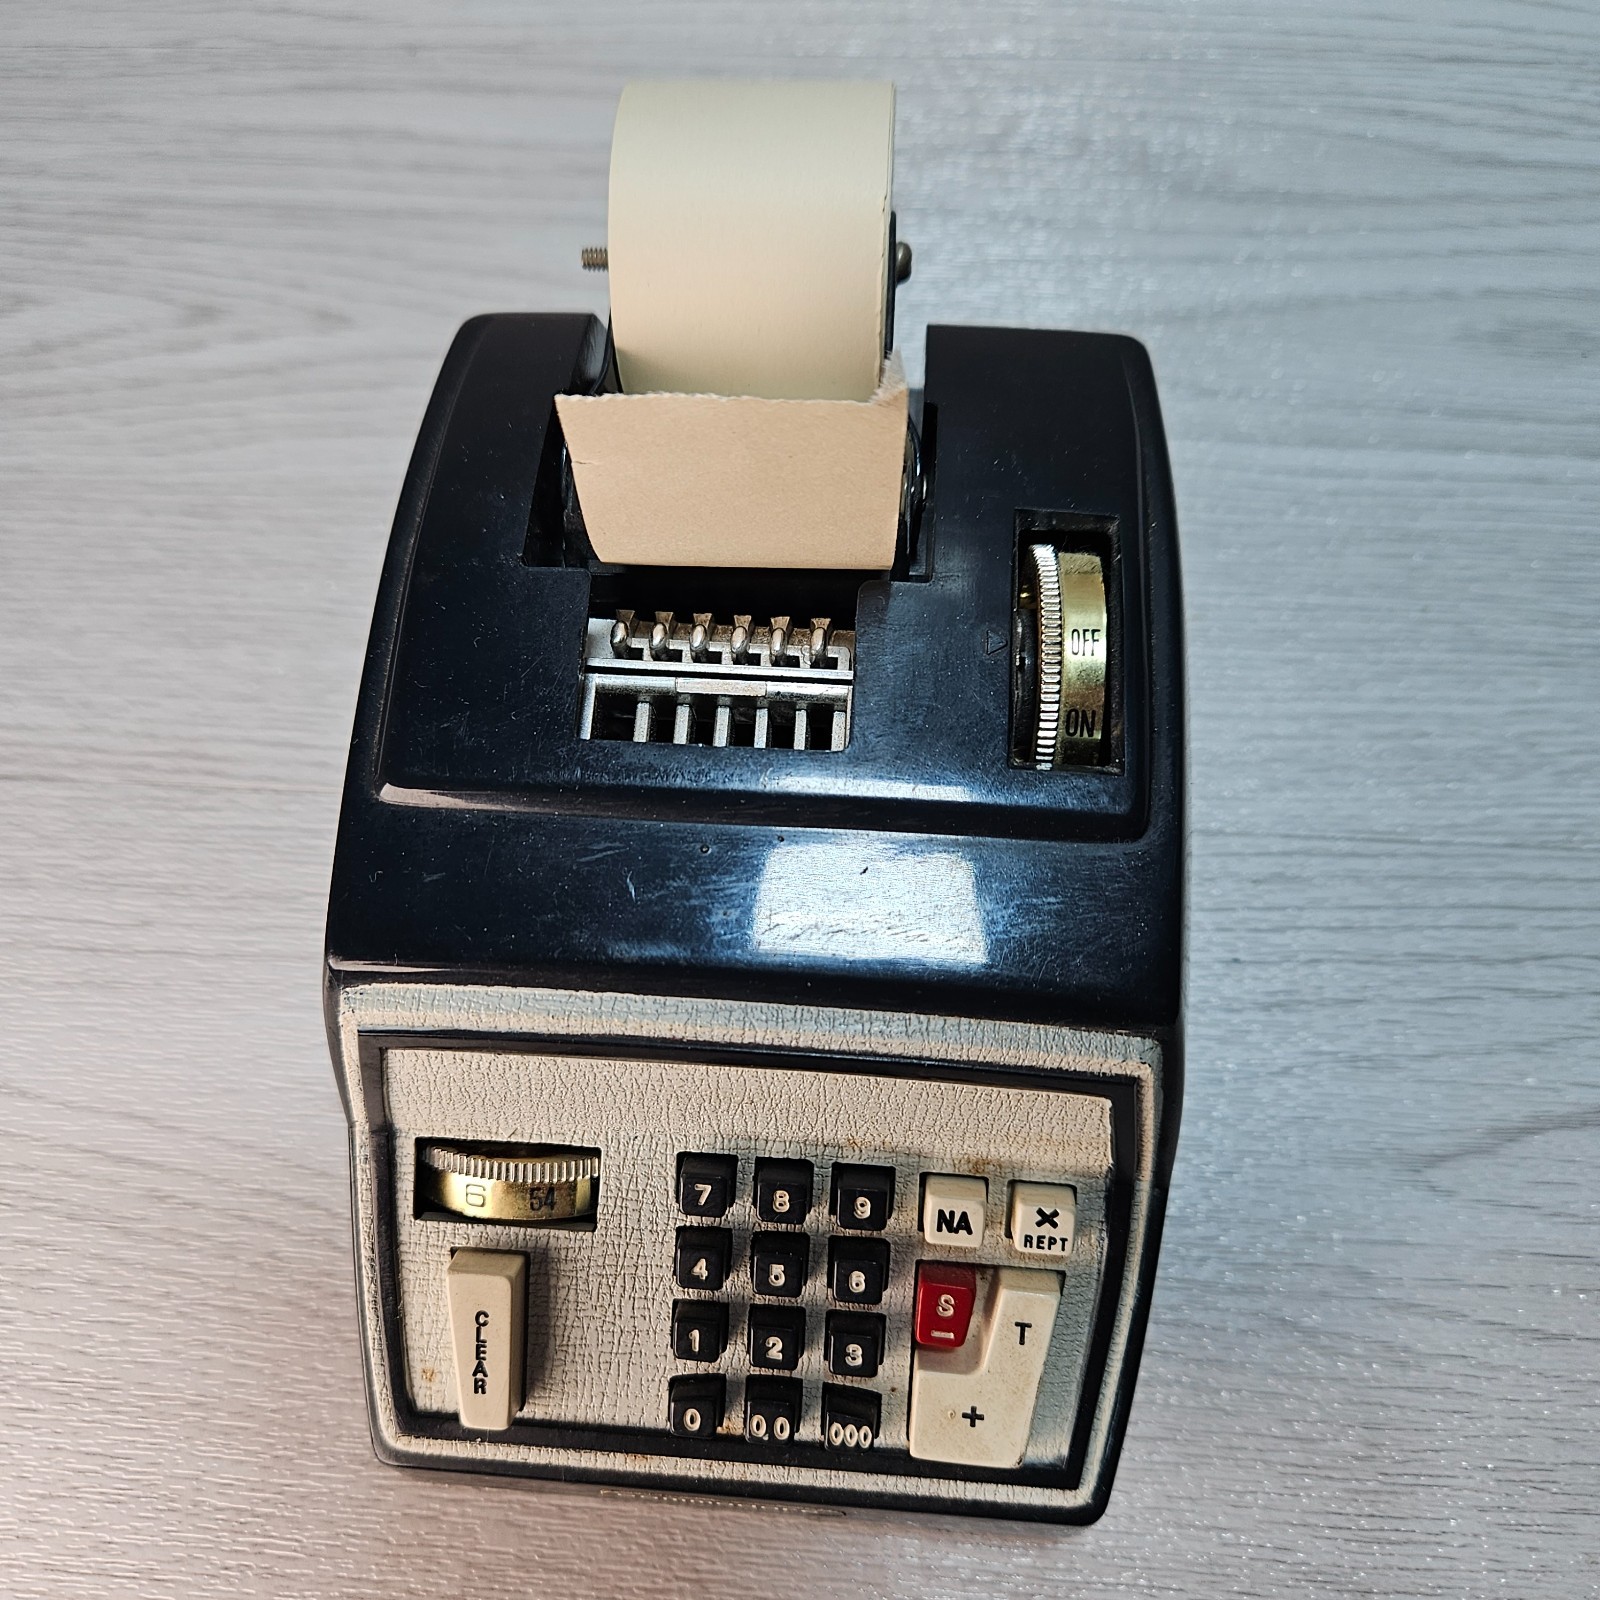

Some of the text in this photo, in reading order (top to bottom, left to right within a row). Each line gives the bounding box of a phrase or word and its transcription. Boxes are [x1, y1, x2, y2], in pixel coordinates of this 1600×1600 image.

[1071, 628, 1101, 656] OFF
[1065, 708, 1096, 738] ON
[465, 1183, 487, 1208] 6
[693, 1183, 712, 1206] 7
[773, 1190, 790, 1213] 8
[853, 1196, 871, 1219] 9
[936, 1208, 973, 1235] NA
[1023, 1234, 1068, 1252] REPT
[691, 1258, 708, 1280] 4
[768, 1263, 786, 1287] 5
[848, 1270, 866, 1293] 6
[936, 1293, 955, 1318] S
[688, 1329, 700, 1352] 1
[1014, 1321, 1033, 1346] T
[472, 1310, 490, 1395] CLEAR
[765, 1336, 783, 1361] 2
[845, 1343, 863, 1367] 3
[683, 1408, 702, 1432] 0
[828, 1421, 873, 1449] 000
